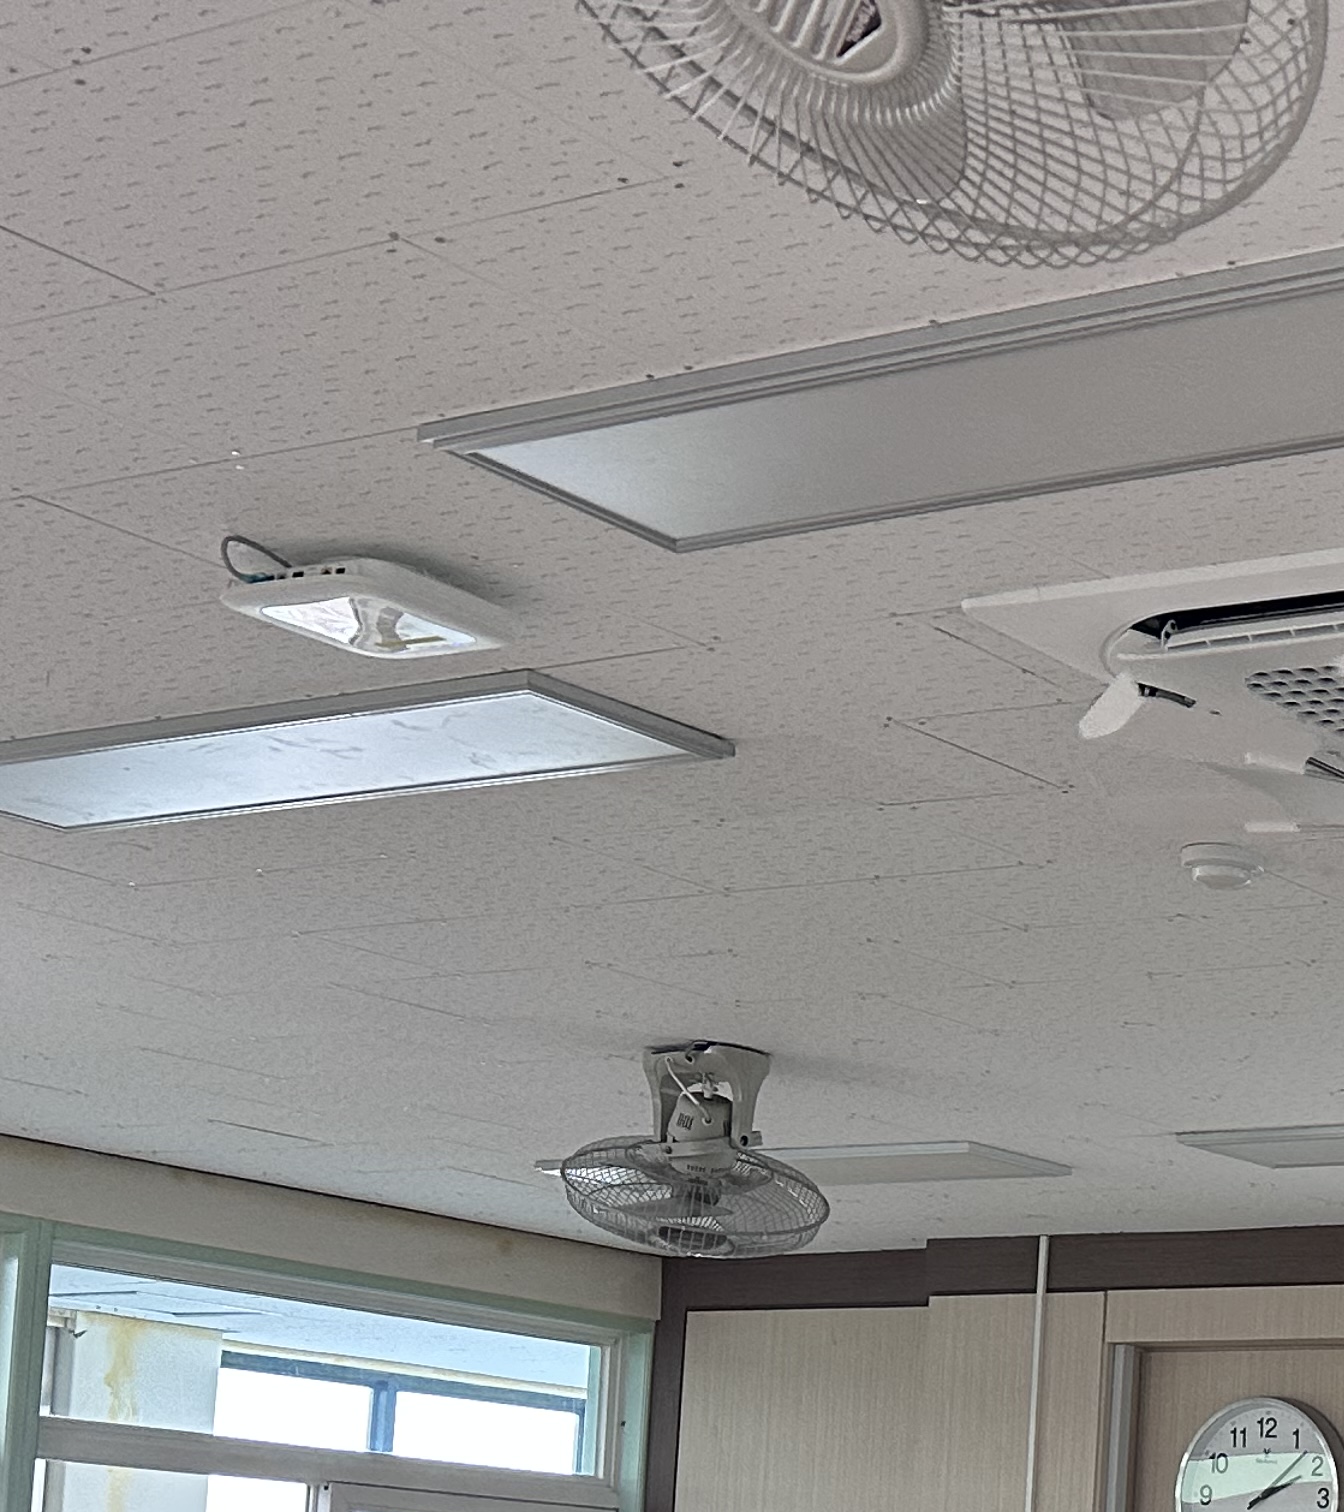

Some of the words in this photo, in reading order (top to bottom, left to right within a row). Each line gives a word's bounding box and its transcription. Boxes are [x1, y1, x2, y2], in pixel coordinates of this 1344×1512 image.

[1230, 1427, 1247, 1448] 11
[1257, 1417, 1278, 1438] 12
[1292, 1428, 1300, 1449] 1
[1210, 1453, 1229, 1474] 10
[1311, 1456, 1324, 1476] 2
[1200, 1484, 1213, 1506] 9
[1316, 1487, 1330, 1509] 3
